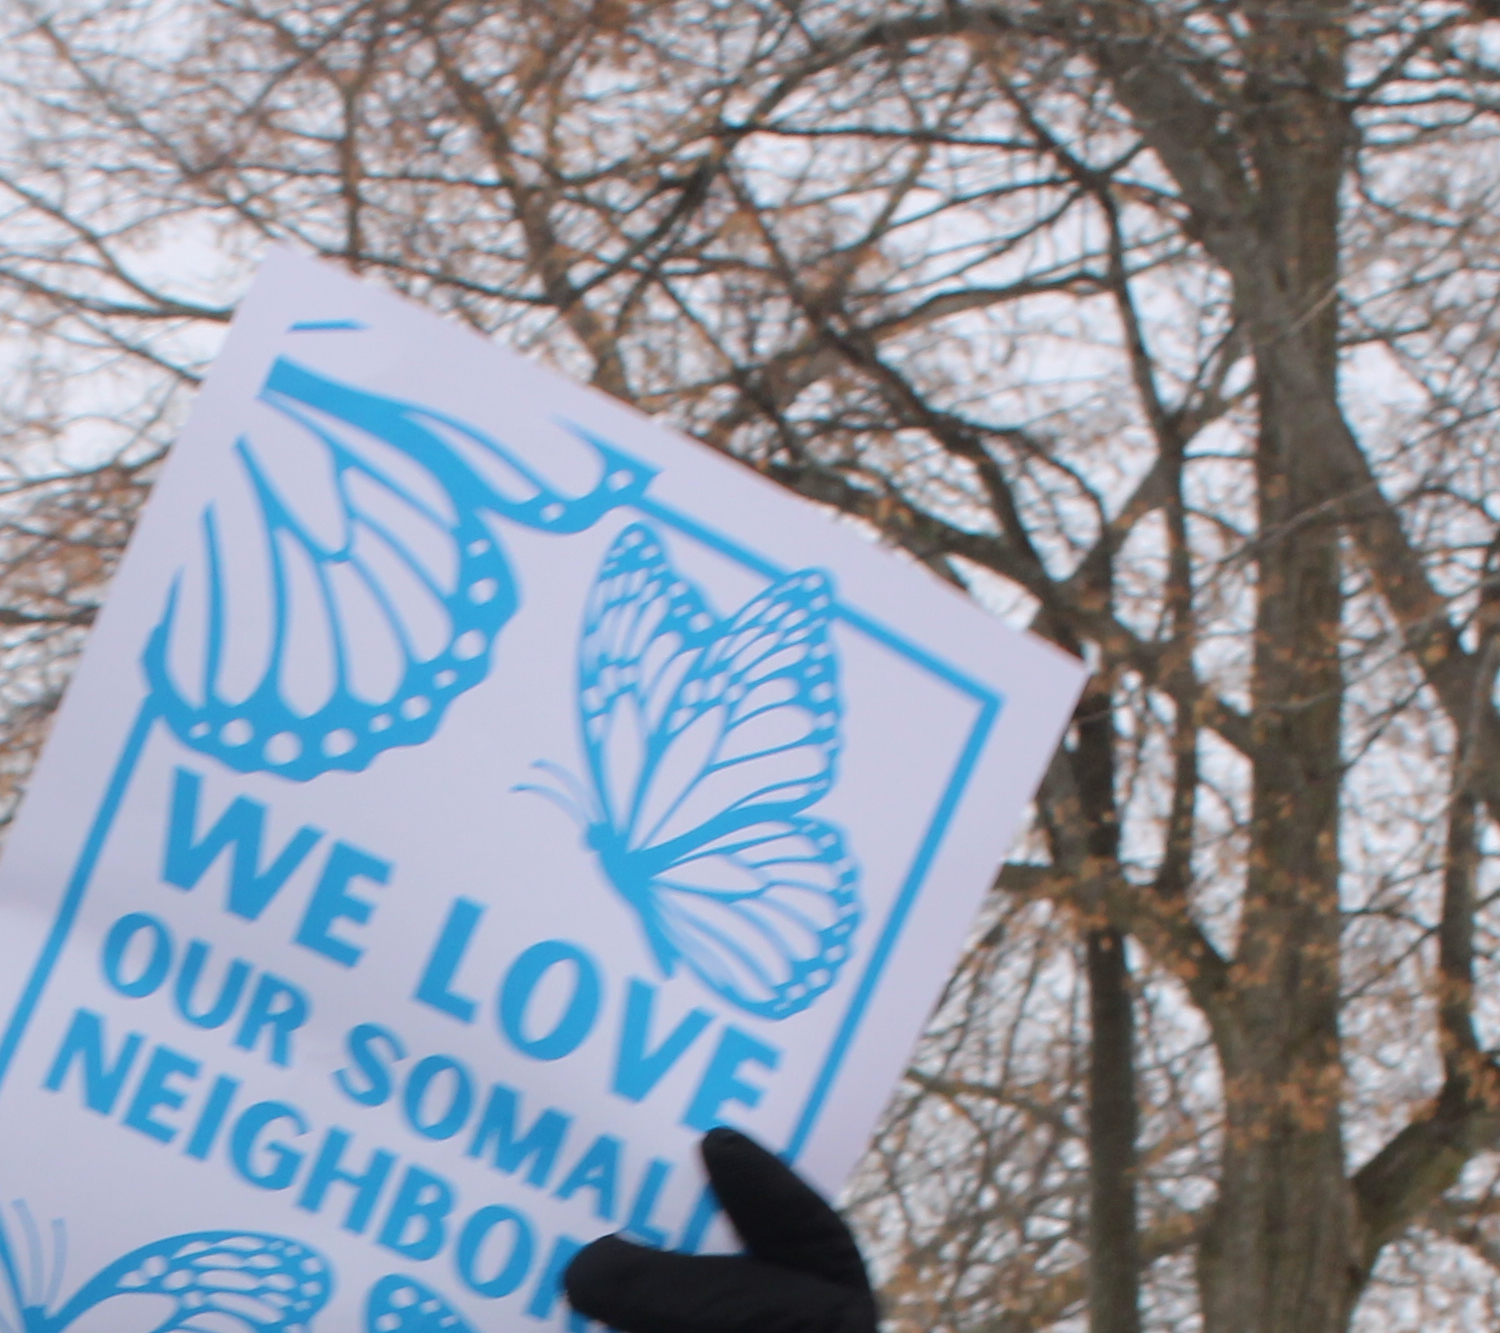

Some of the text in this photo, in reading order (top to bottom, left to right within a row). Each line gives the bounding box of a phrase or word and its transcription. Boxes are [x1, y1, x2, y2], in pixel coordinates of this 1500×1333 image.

[100, 910, 312, 1069] OUR
[161, 764, 785, 1134] WE LOVE
